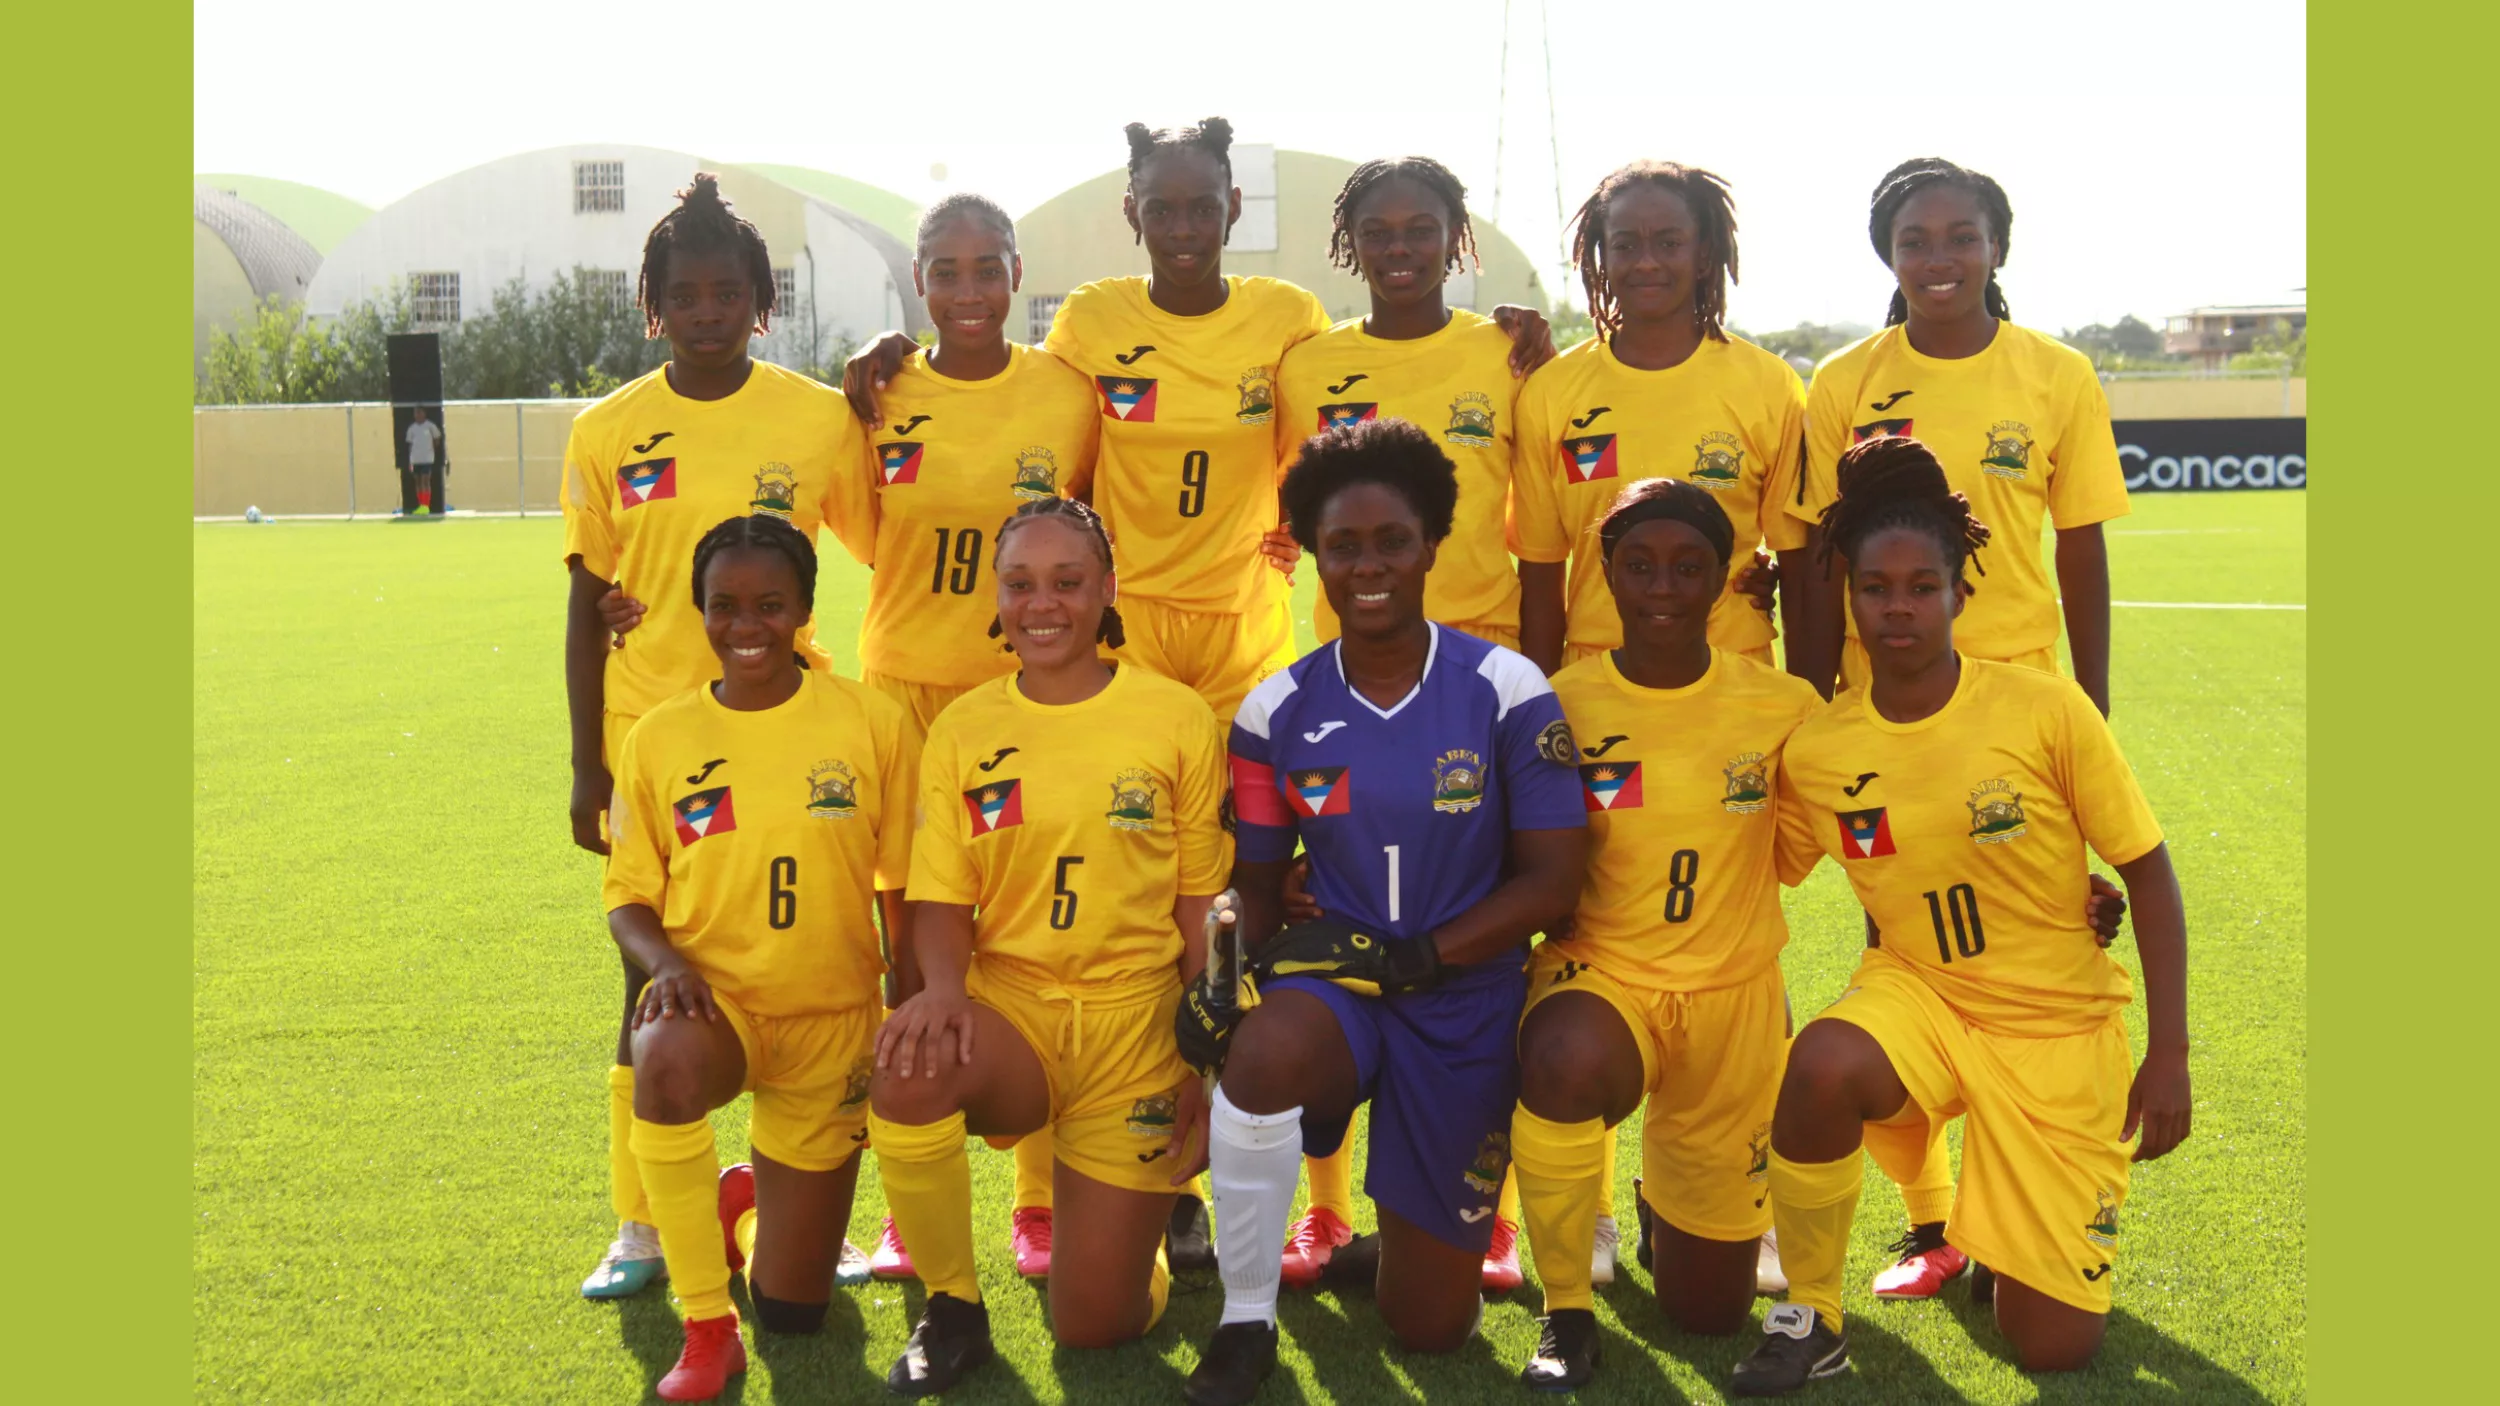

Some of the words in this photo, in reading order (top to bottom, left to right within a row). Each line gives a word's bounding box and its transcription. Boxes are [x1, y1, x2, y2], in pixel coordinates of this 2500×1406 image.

[1179, 450, 1209, 518] 9
[932, 528, 982, 595] 19
[1436, 749, 1479, 769] ABFA
[769, 856, 797, 930] 6
[1050, 856, 1084, 930] 5
[1384, 845, 1400, 922] 1
[1664, 849, 1699, 923] 8
[1923, 883, 1986, 964] 10
[1189, 991, 1215, 1032] ELITE
